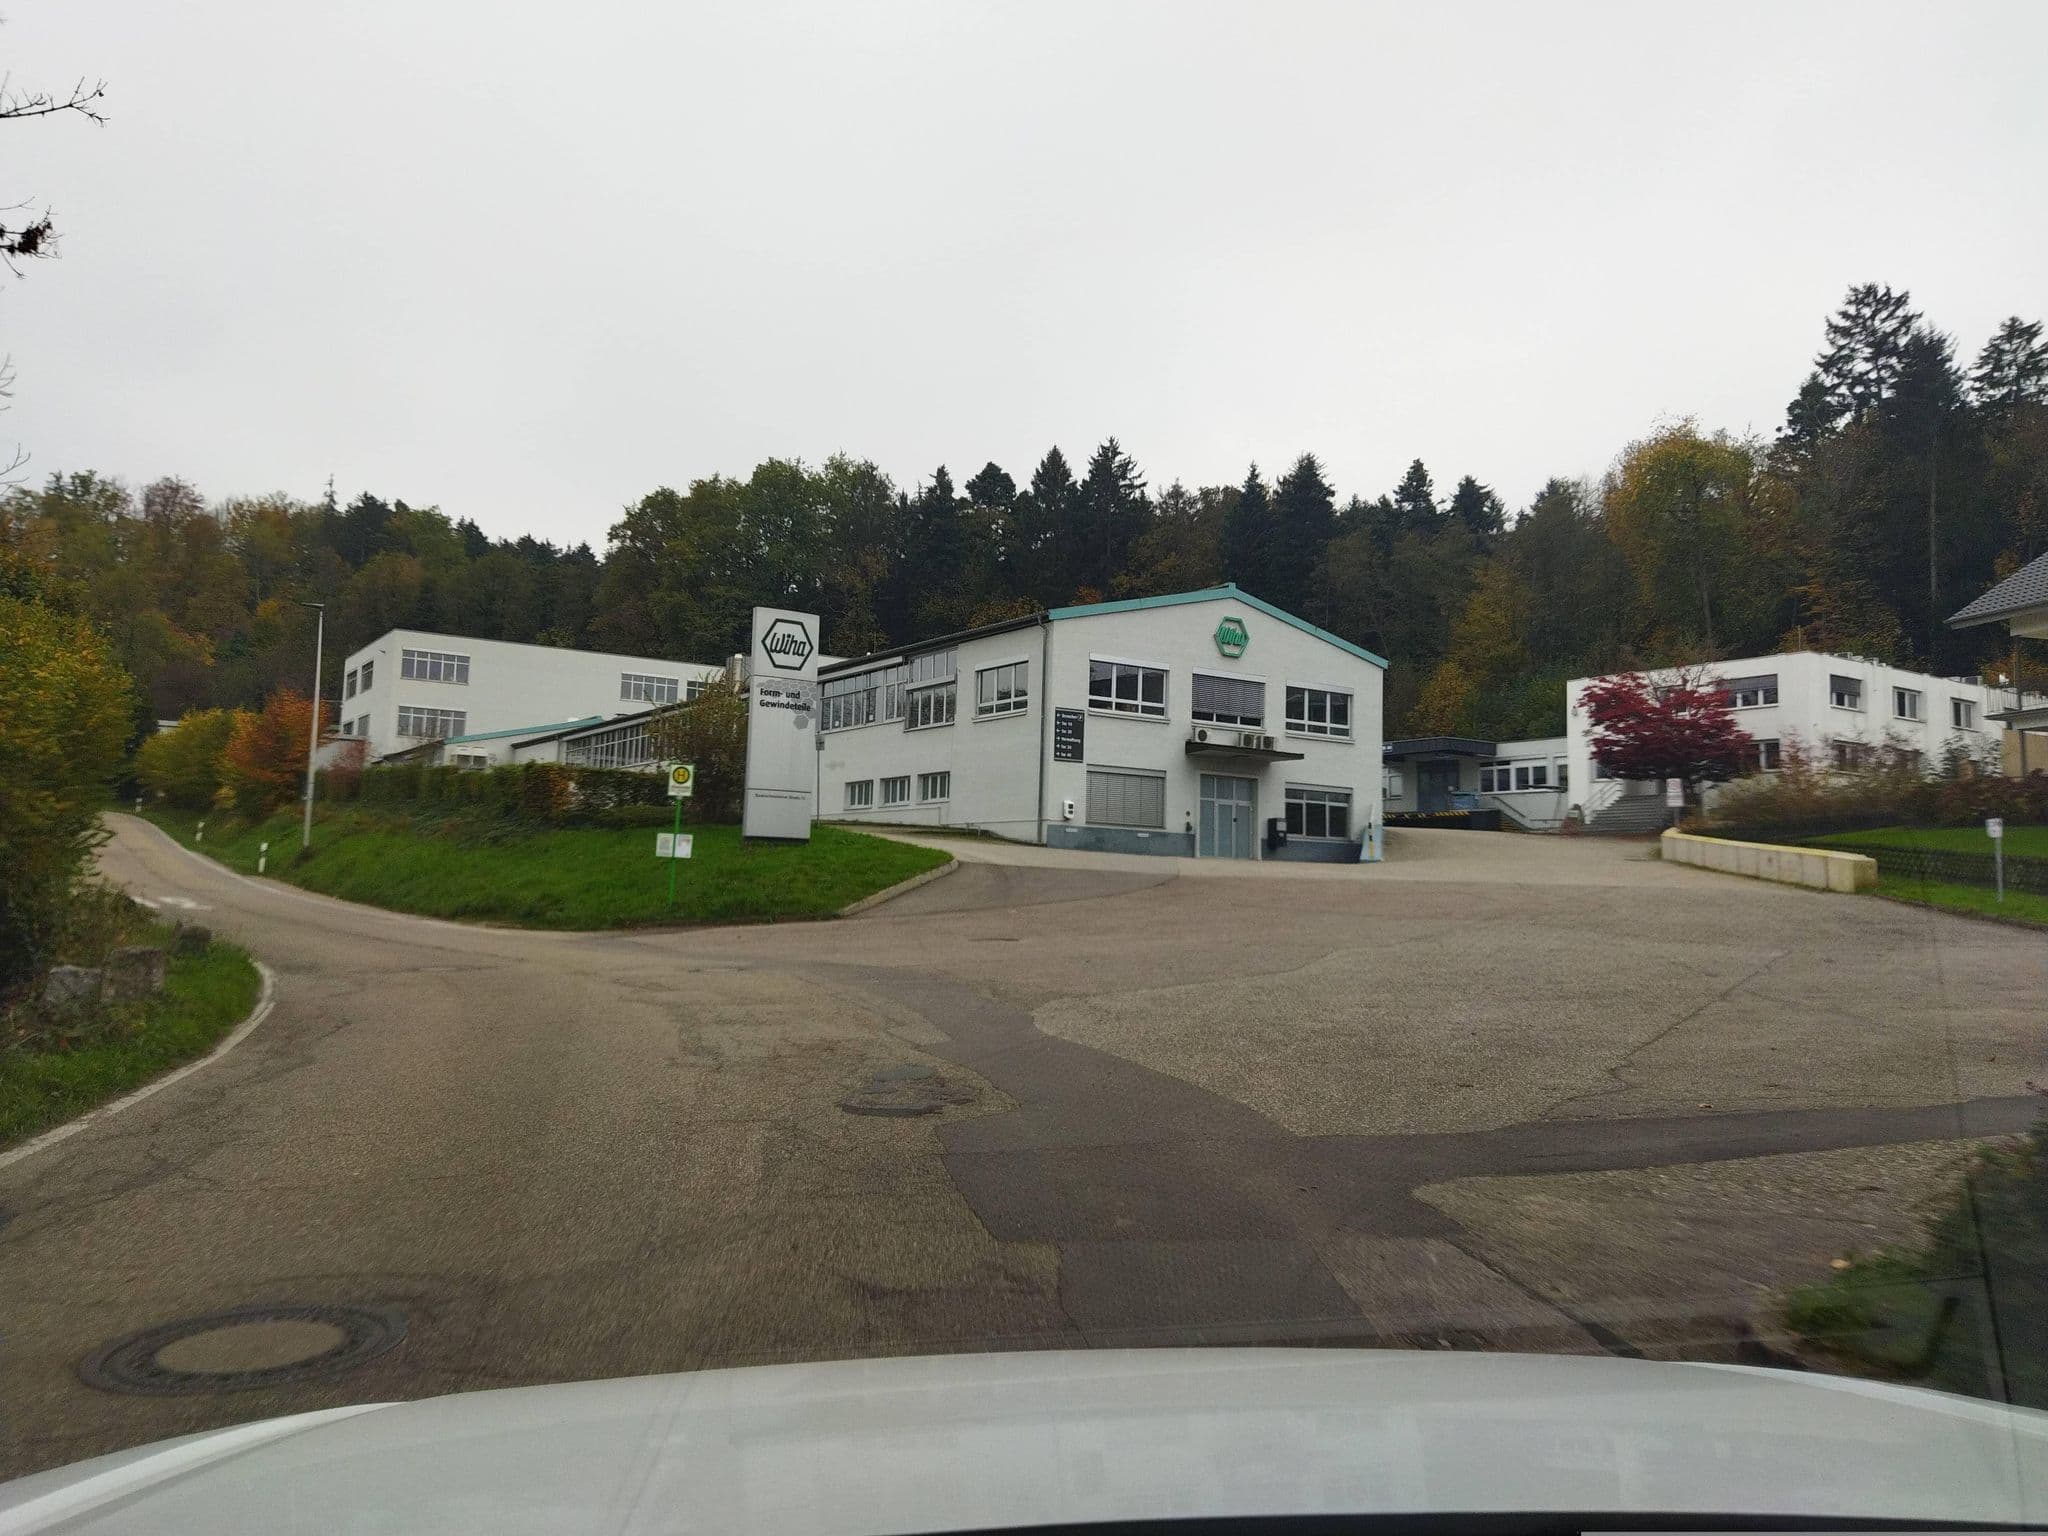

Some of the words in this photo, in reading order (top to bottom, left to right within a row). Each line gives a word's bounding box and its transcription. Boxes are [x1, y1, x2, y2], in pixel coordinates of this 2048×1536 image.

[769, 632, 807, 657] Wiha
[760, 688, 783, 698] Form-
[785, 690, 801, 699] und
[759, 699, 811, 712] Gewindeteile
